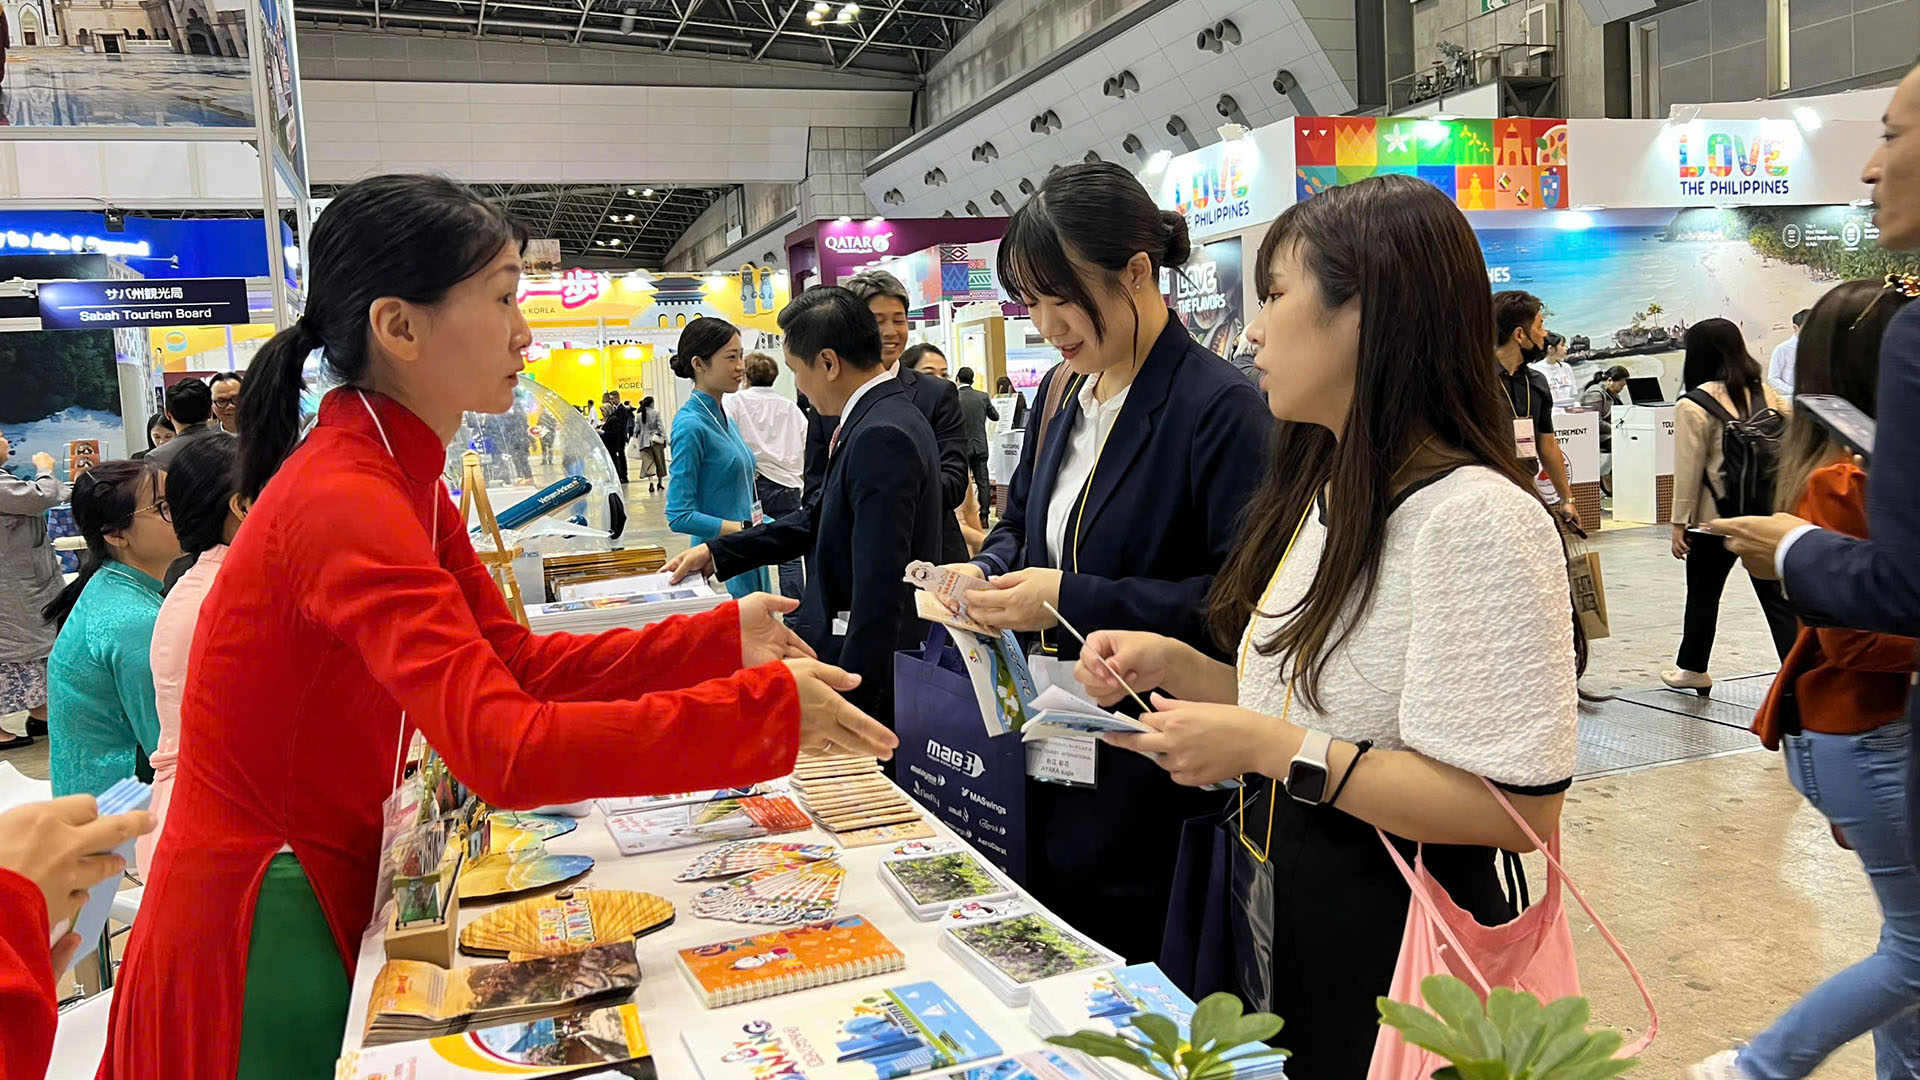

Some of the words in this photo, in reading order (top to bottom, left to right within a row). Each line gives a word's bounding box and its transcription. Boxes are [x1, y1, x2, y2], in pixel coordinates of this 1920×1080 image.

[1679, 133, 1789, 178] LOVE
[1680, 181, 1705, 195] THE
[1710, 180, 1789, 195] PHILIPPINES
[1194, 200, 1250, 228] PHILIPPINES
[825, 236, 872, 251] QATAR
[105, 287, 183, 300] サバ州観光局
[79, 310, 120, 322] Sabah
[122, 309, 172, 320] Tourism
[175, 308, 212, 318] Board
[1554, 428, 1587, 437] ETIREMENT
[969, 791, 1007, 815] MASwings
